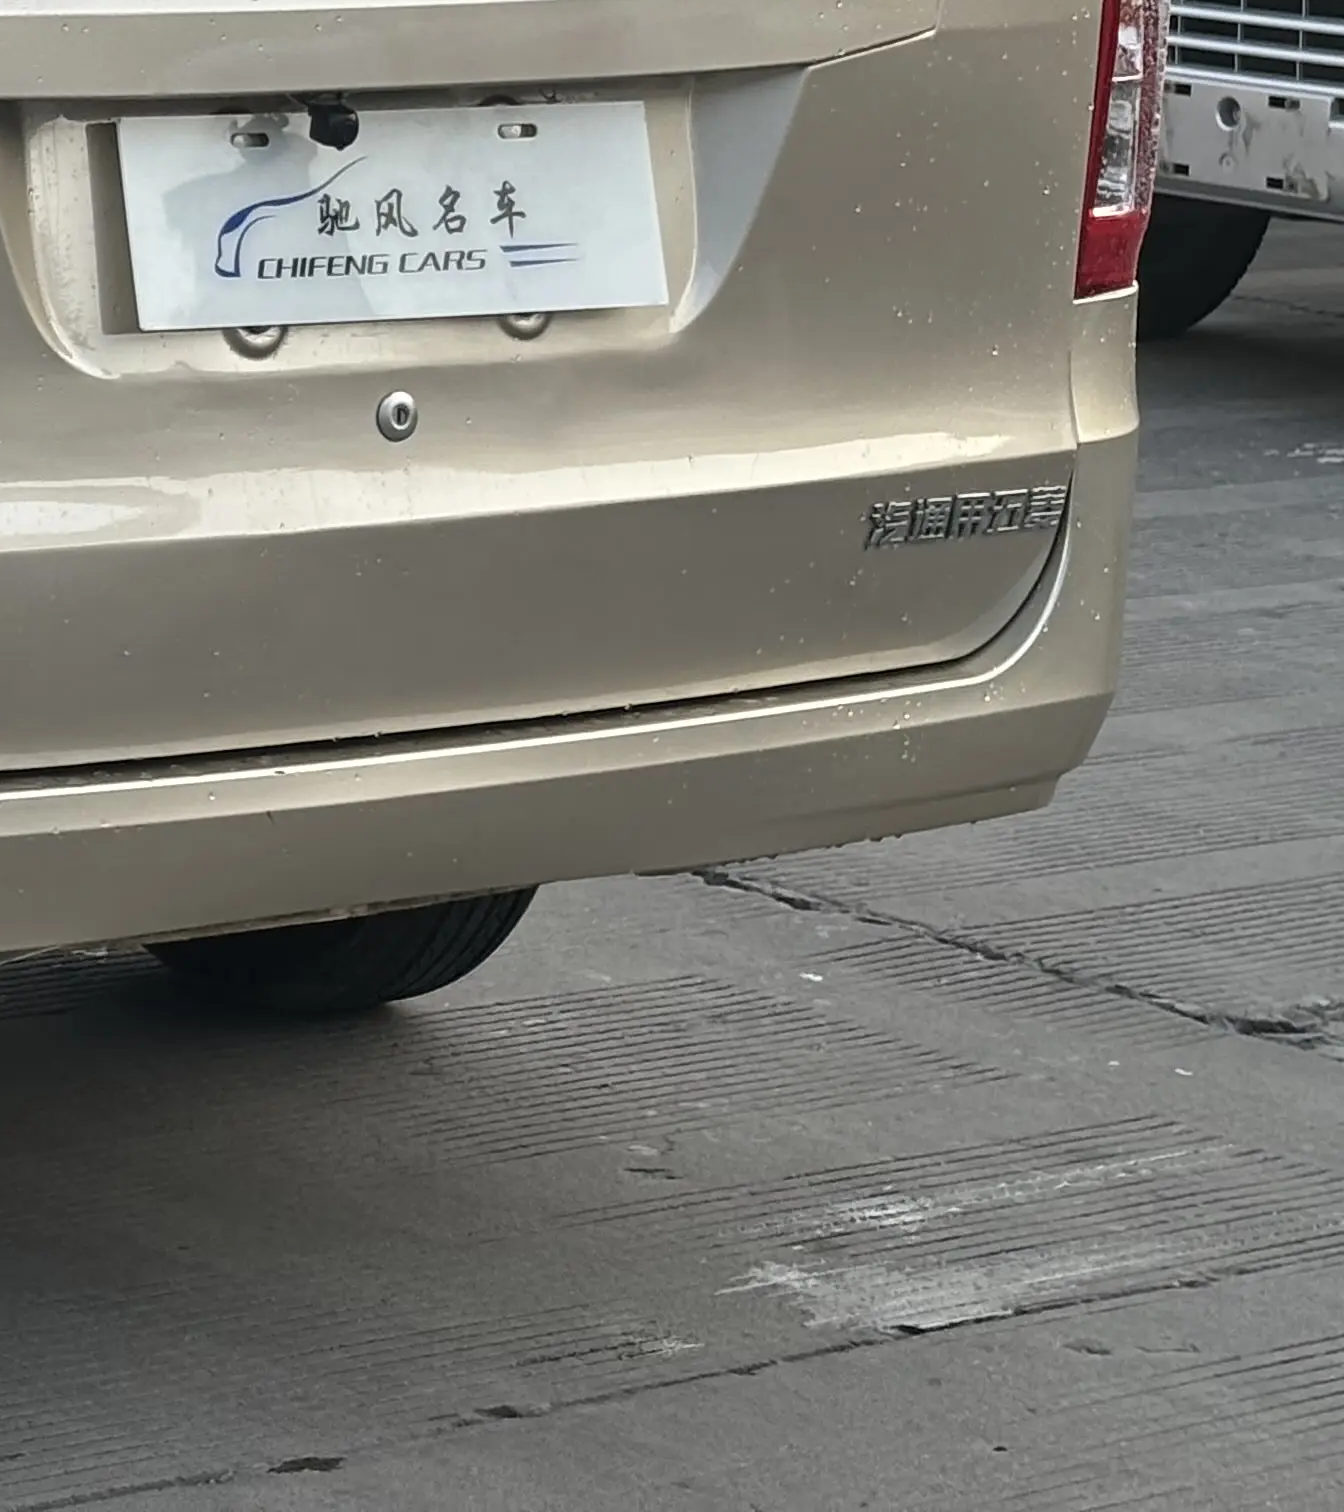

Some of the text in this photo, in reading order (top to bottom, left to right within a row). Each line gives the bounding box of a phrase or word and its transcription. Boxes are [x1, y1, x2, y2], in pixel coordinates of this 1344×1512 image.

[316, 179, 527, 238] 驰风名车
[257, 249, 487, 280] CHIFENG CARS
